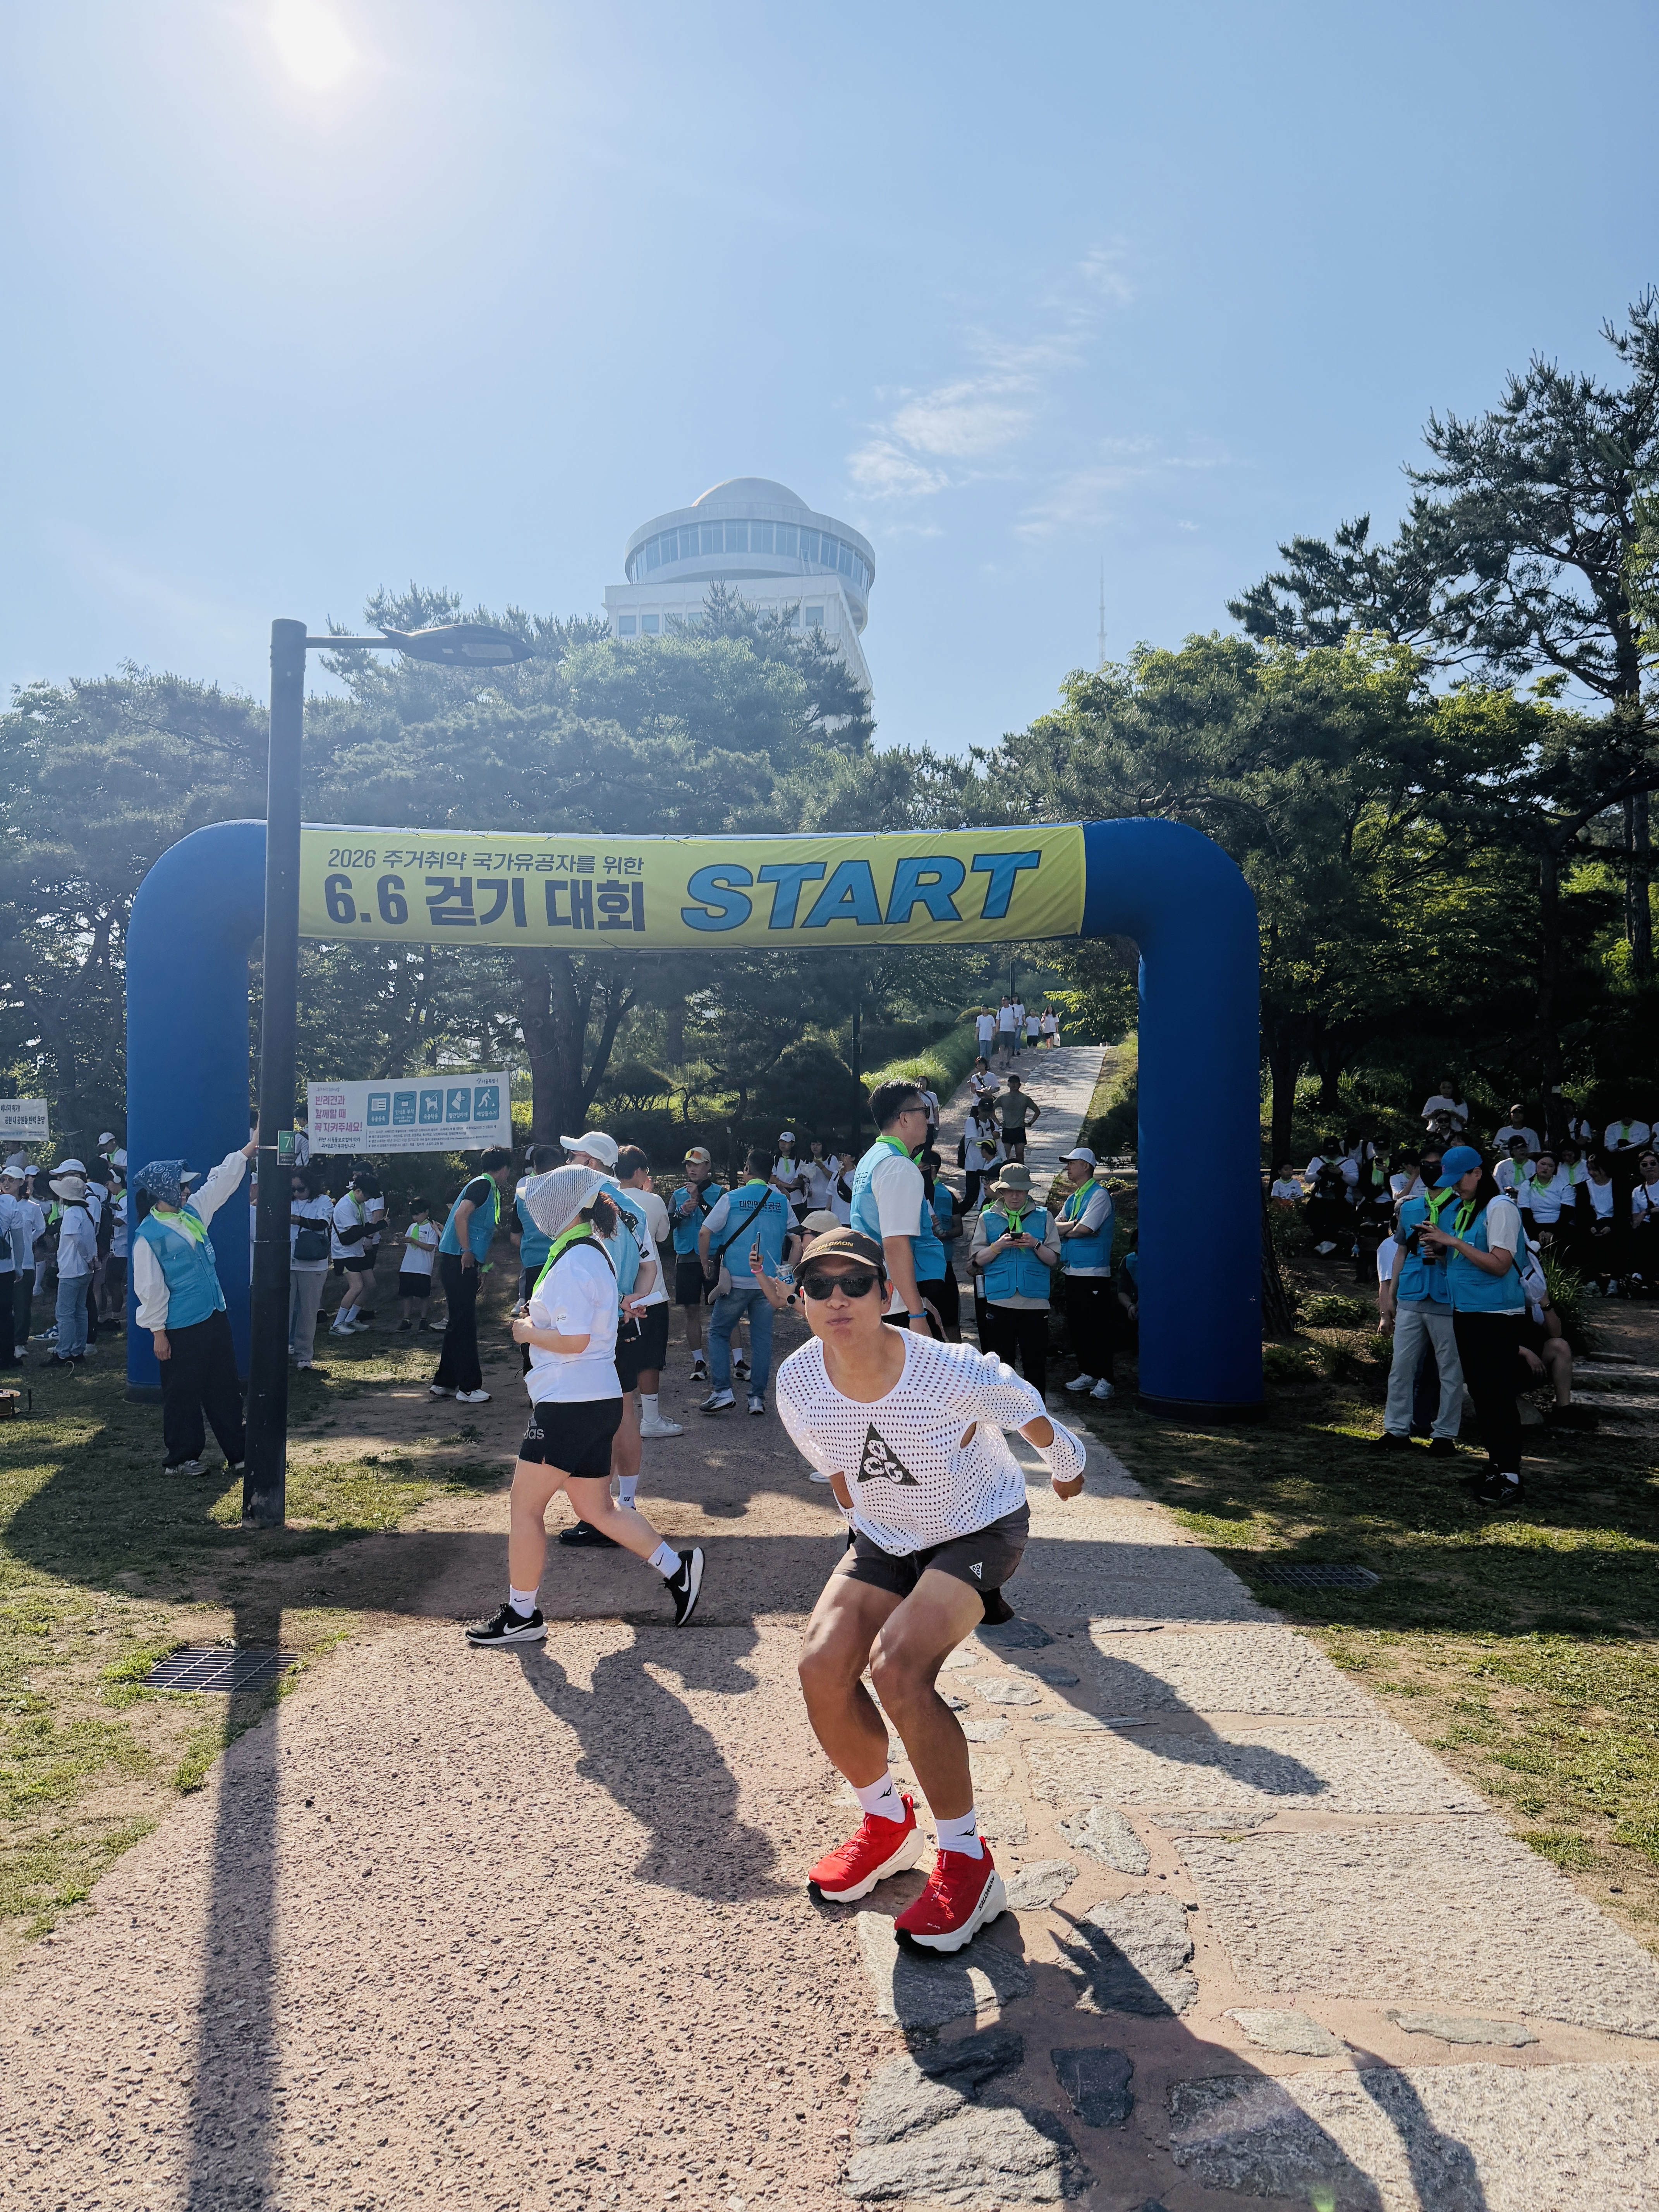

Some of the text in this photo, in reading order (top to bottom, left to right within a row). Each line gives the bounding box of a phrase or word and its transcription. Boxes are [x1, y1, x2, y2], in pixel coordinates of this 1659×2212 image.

[328, 849, 644, 875] 2026 주거취약 국가유공자를 위한
[681, 850, 1042, 931] START
[325, 874, 646, 931] 6.6 걷기 대회
[316, 1095, 345, 1105] 반려견과
[316, 1109, 346, 1119] 함께할 때
[5, 1116, 12, 1124] 공원
[12, 1116, 16, 1125] 내
[17, 1116, 28, 1124] 공원등
[29, 1116, 36, 1124] 탄력
[315, 1122, 322, 1132] 꼭
[323, 1122, 362, 1132] 지켜주세요!
[816, 1241, 854, 1252] SALOMON
[524, 1425, 544, 1439] das
[979, 1874, 994, 1911] SALOMON
